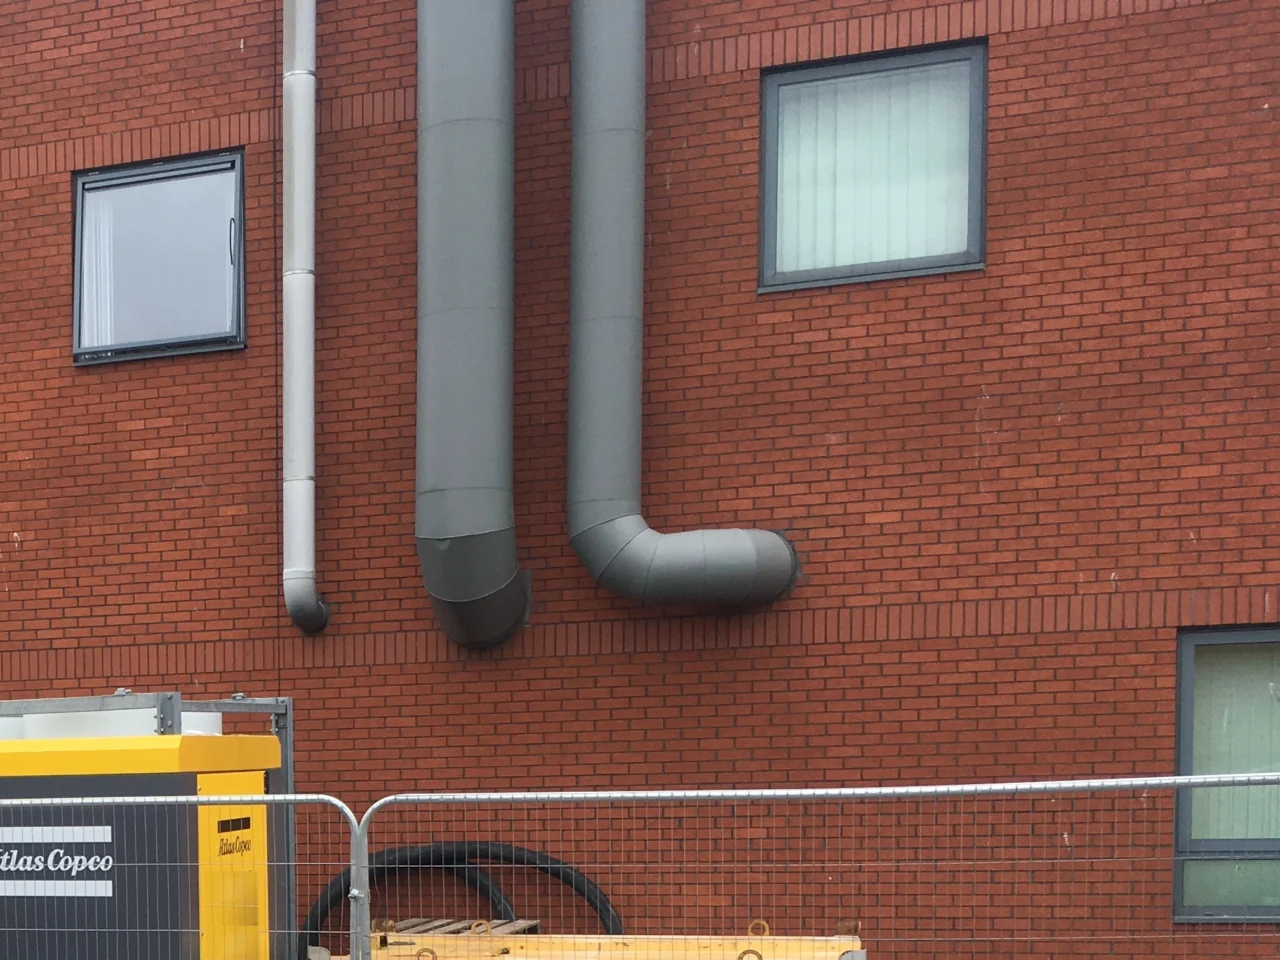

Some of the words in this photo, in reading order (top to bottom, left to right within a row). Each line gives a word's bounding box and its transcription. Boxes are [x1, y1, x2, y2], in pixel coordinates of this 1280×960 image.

[218, 838, 234, 857] Atlas
[235, 836, 251, 857] Copco
[47, 849, 113, 876] Copco
